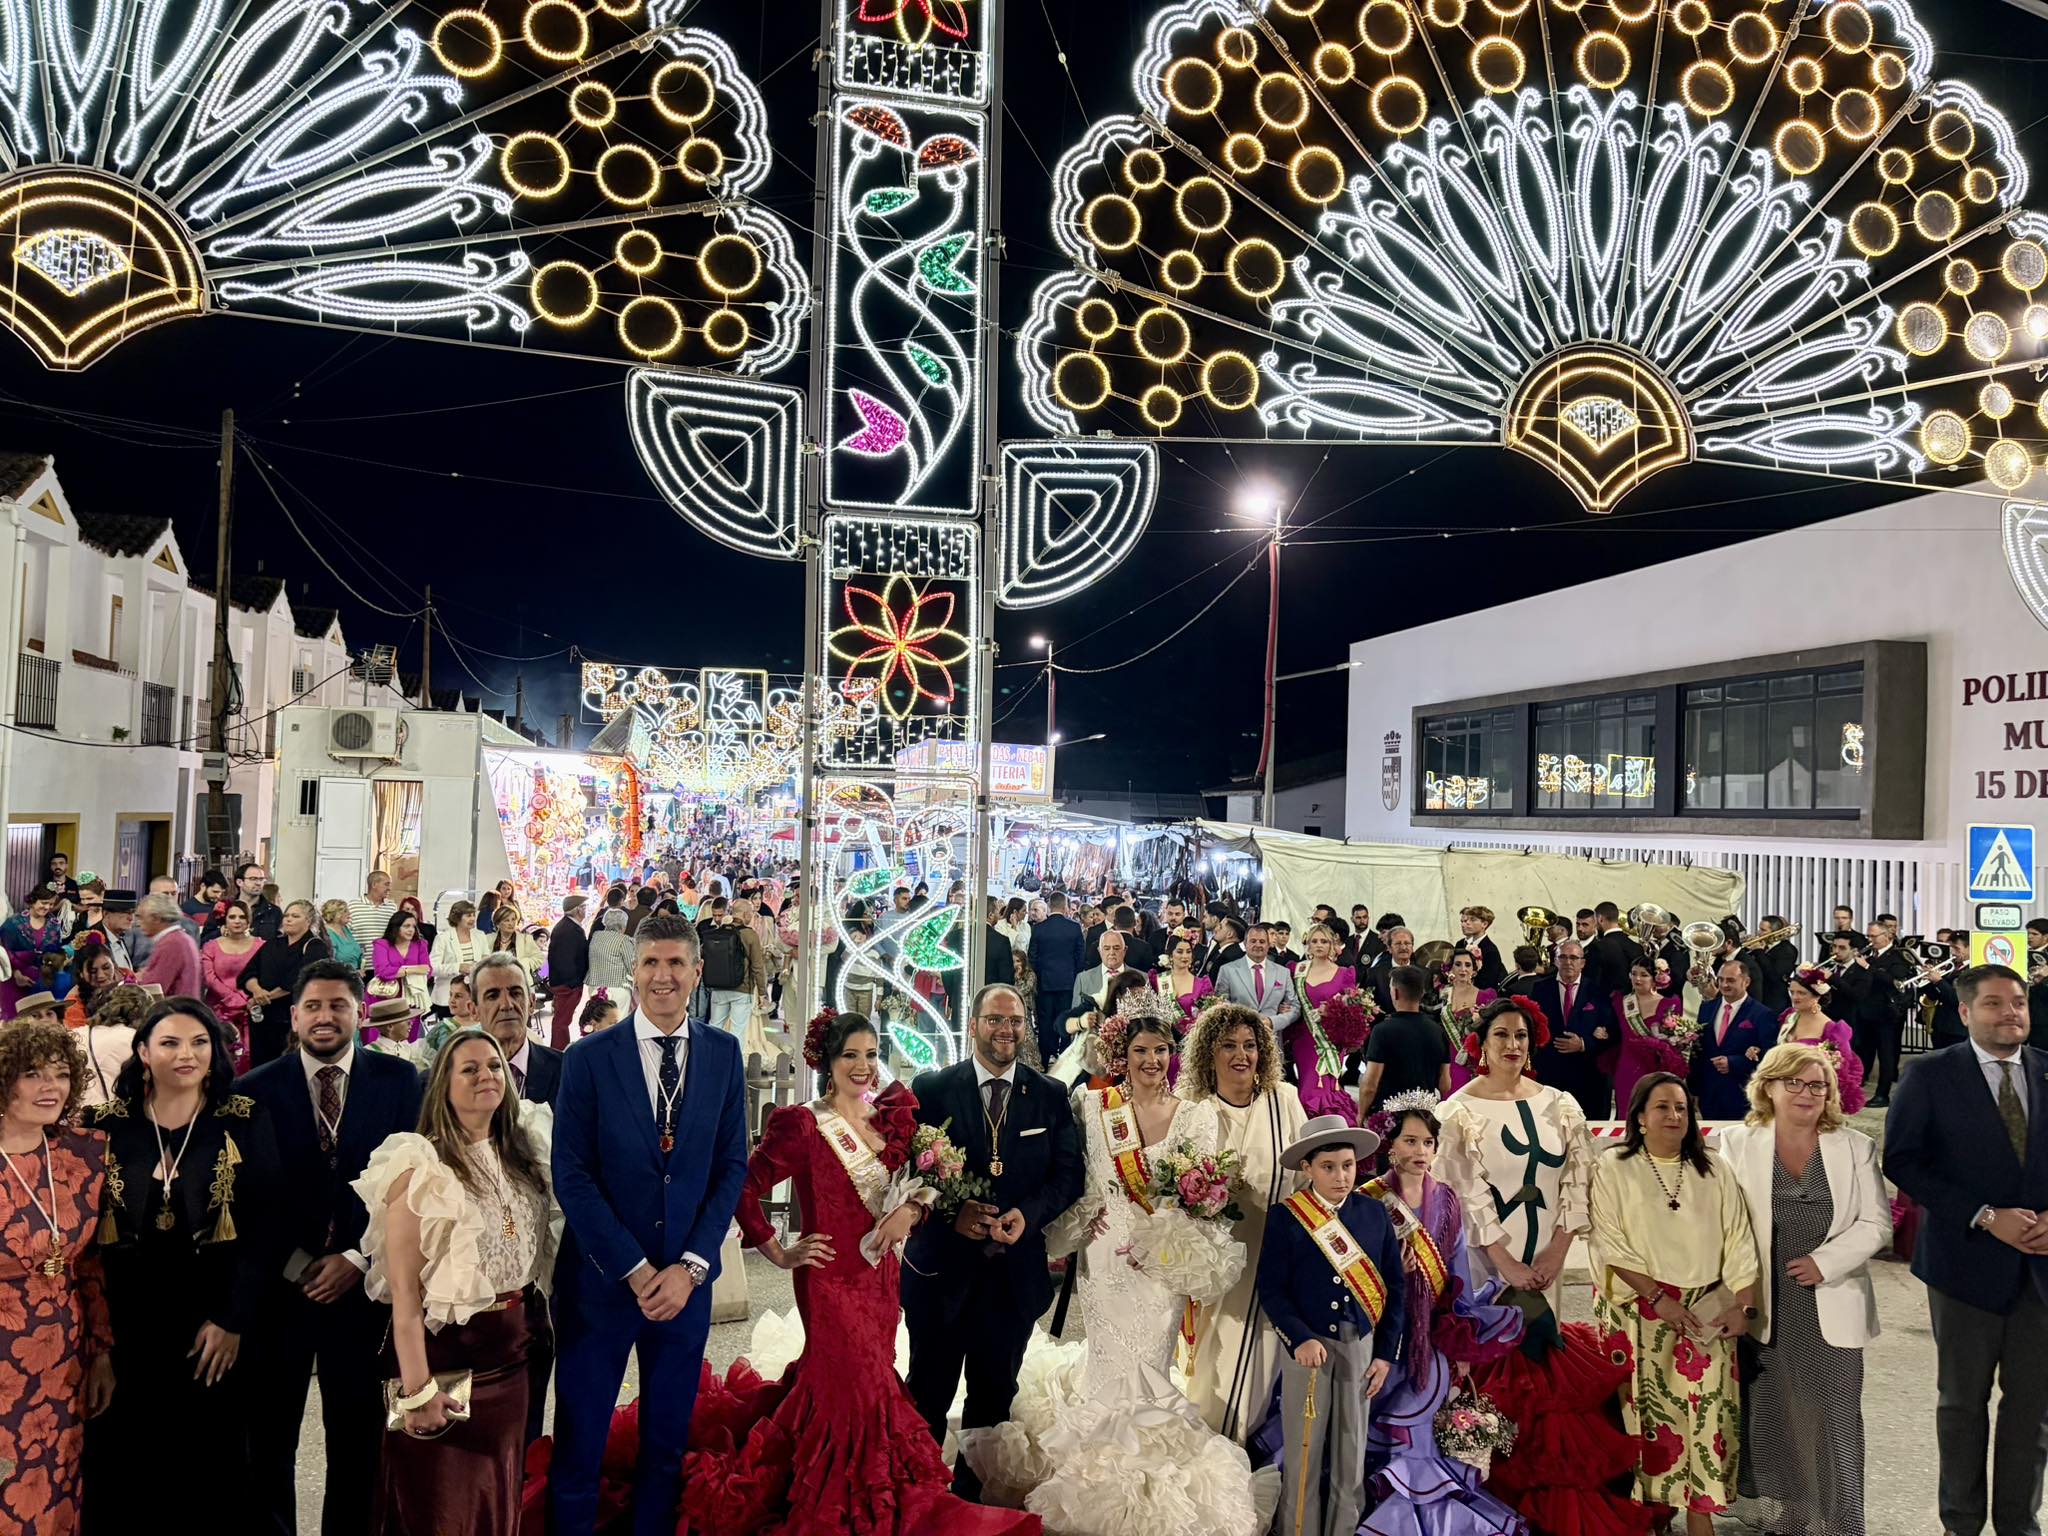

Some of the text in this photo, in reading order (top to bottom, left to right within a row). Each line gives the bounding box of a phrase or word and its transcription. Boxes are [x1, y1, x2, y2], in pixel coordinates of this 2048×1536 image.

[992, 765, 1026, 780] TTERIA
[1975, 770, 2006, 799] 15
[1990, 908, 2009, 916] PASO
[1983, 918, 2017, 926] ELEVADO
